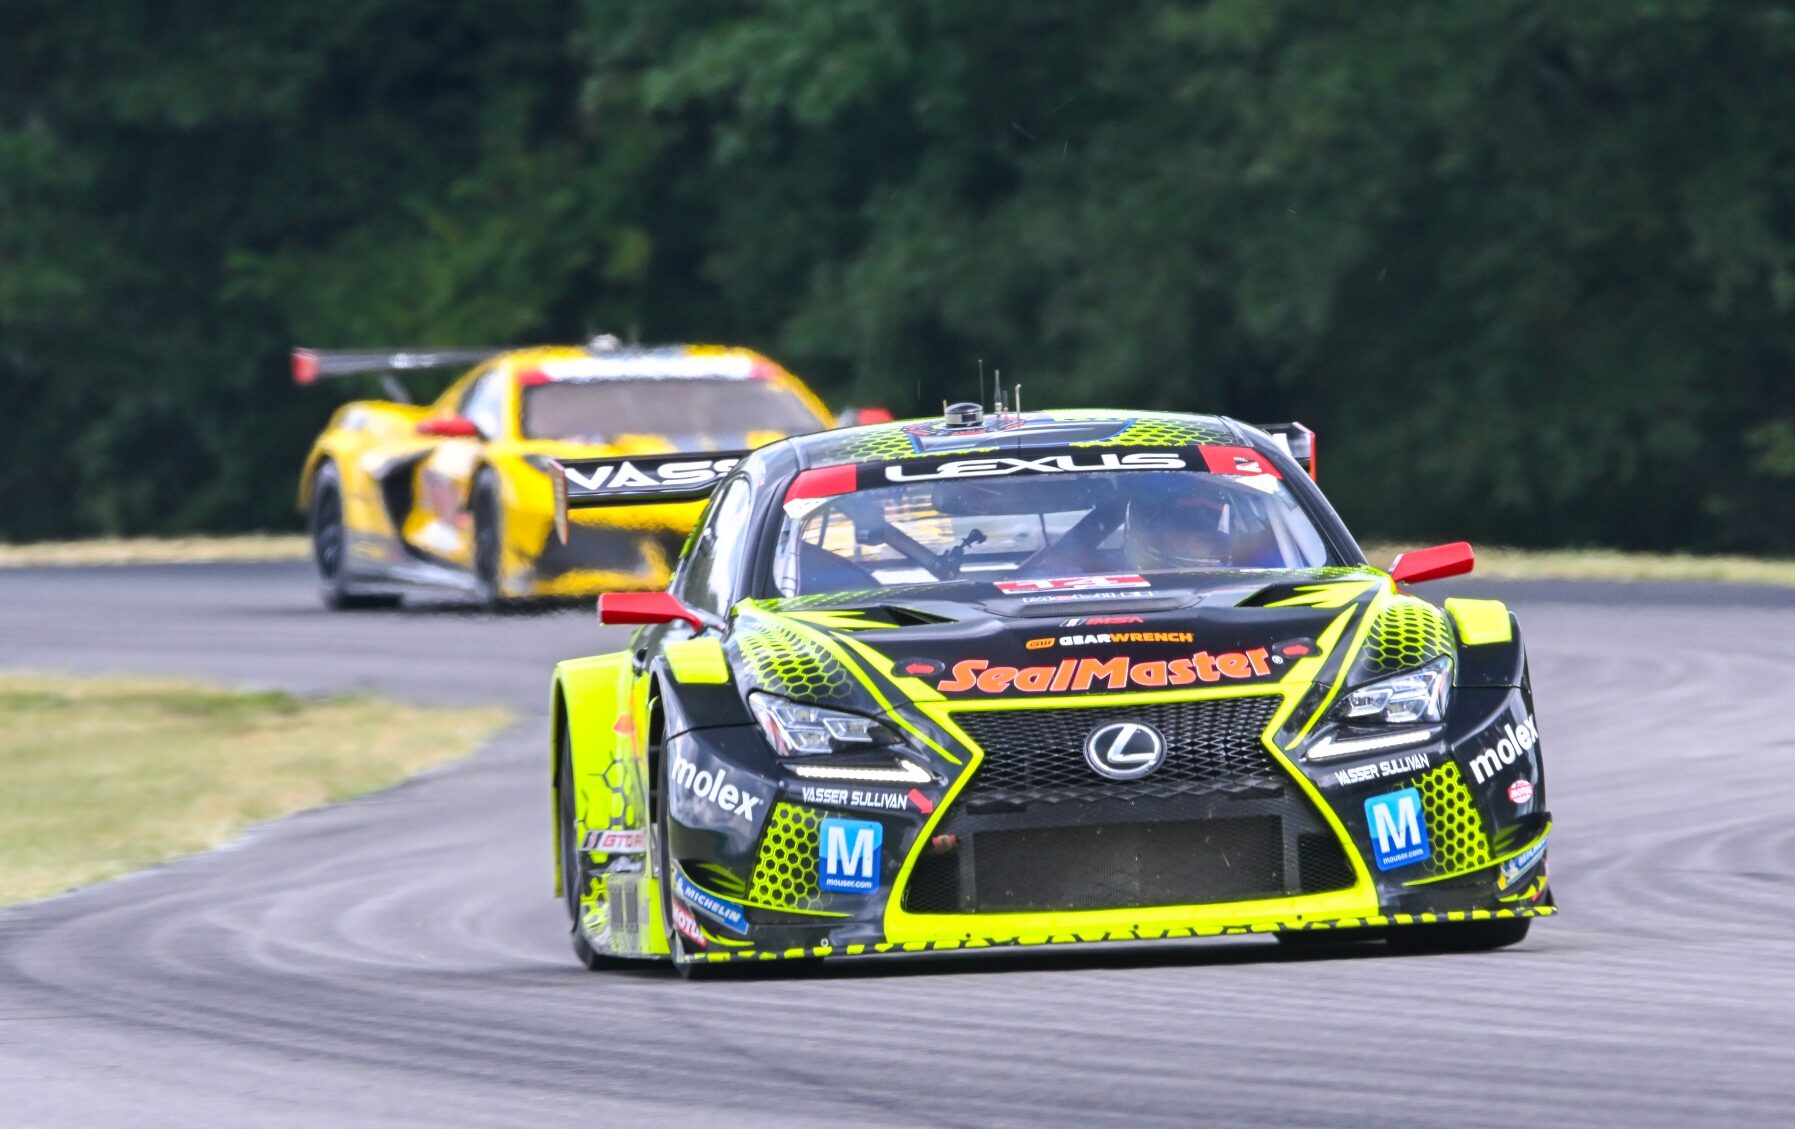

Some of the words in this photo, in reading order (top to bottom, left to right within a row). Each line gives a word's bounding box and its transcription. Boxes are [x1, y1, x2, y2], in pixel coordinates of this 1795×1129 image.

[885, 453, 1186, 482] LEXUS
[1059, 632, 1194, 646] GEARWRENCH
[1469, 713, 1539, 784] molex
[1335, 764, 1380, 786] VASSER
[1379, 753, 1430, 776] SULLIVAN
[671, 755, 760, 822] molex
[802, 786, 848, 806] VASSER
[850, 790, 908, 811] SULLIVAN
[1372, 796, 1422, 854] M
[826, 826, 875, 878] M
[1382, 847, 1424, 864] mouser.com
[826, 878, 872, 889] mouser.com
[684, 886, 741, 923] MICHELIN
